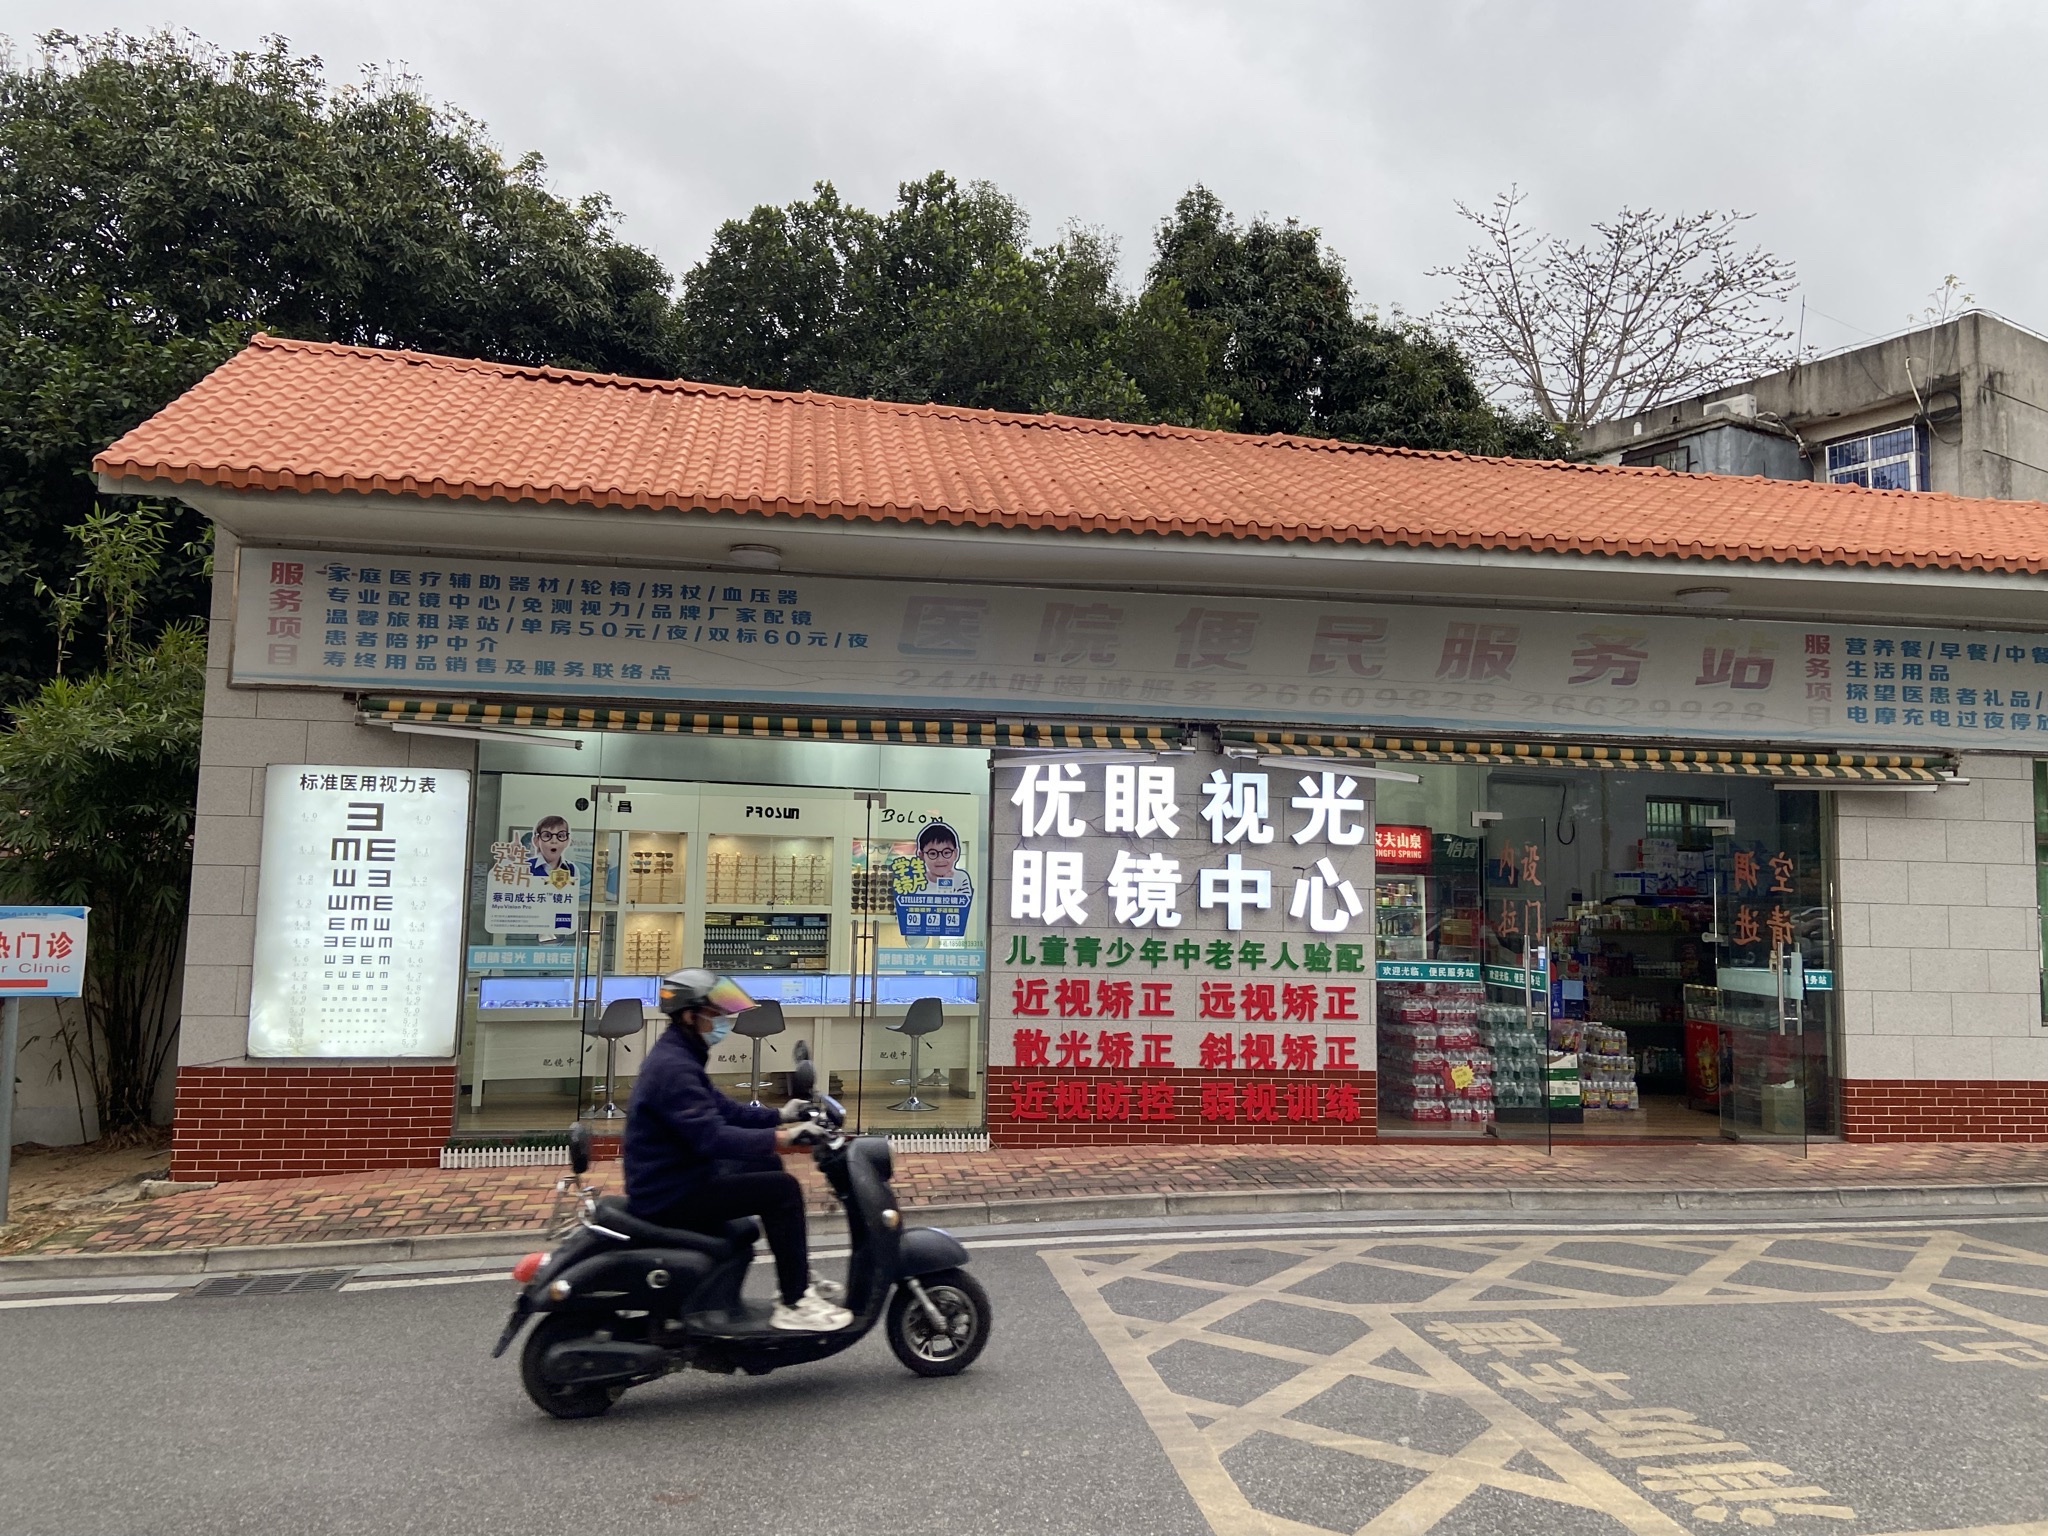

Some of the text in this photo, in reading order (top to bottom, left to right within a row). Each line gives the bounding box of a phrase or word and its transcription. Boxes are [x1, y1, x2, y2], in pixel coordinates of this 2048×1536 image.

[327, 566, 798, 605] 家庭医疗辅助器材/轮椅/拐杖/血压器
[267, 561, 305, 667] 服务项目
[326, 587, 812, 626] 专业配镜中心/免测视力/品牌厂家配镜
[324, 629, 499, 653] 患者陪护中介
[897, 595, 1778, 690] 医院便民服务站
[322, 651, 671, 681] 寿终用品销售及服务联络点
[1845, 661, 1950, 682] 生活用品
[1804, 633, 1832, 727] 服务项目
[299, 773, 436, 794] 标准医用视力表
[1010, 763, 1365, 846] 优眼视光
[492, 841, 531, 865] 学生
[1375, 831, 1422, 849] 农夫山泉
[891, 857, 926, 878] 学生
[1375, 849, 1422, 859] NGFU SPRING
[493, 863, 533, 888] 镜片
[893, 874, 928, 895] 镜片
[1010, 849, 1364, 933] 眼镜中心
[1005, 935, 1365, 973] 儿童青少年中老年人验配
[19, 963, 71, 973] Clinic
[1011, 978, 1359, 1022] 近视矫正 远视矫正
[717, 1053, 752, 1063] 配镜中
[879, 1051, 912, 1060] 配镜中
[1013, 1028, 1359, 1071] 散光矫正 斜视矫正
[1011, 1080, 1361, 1123] 近视防控 弱视训练
